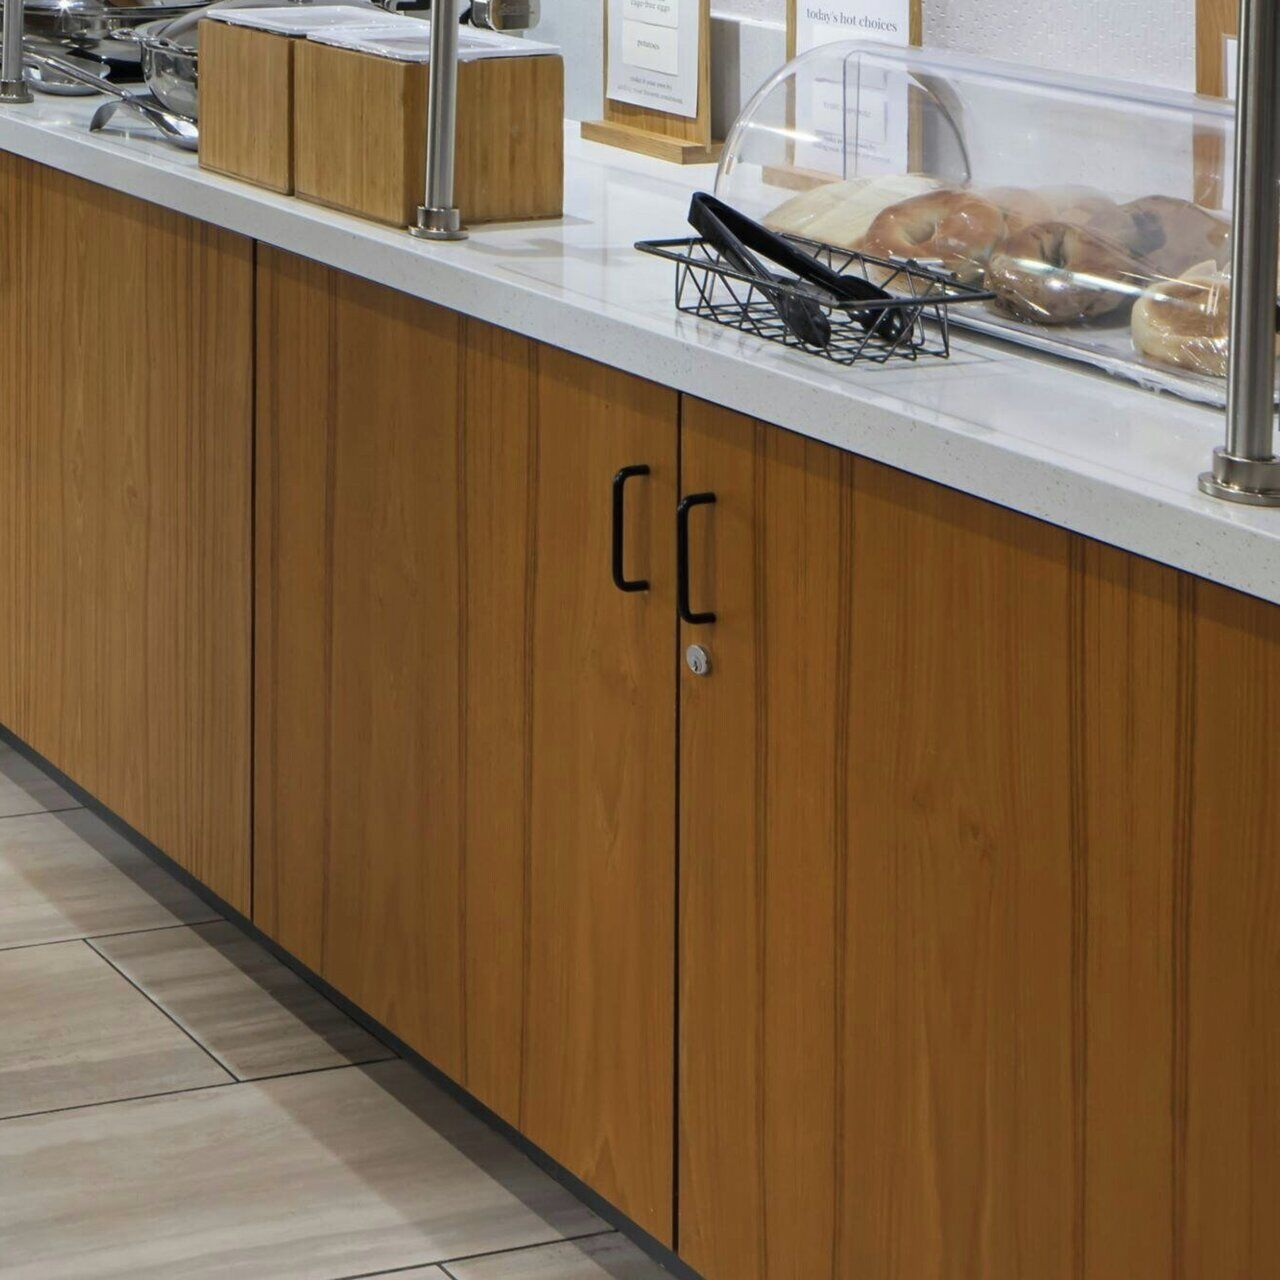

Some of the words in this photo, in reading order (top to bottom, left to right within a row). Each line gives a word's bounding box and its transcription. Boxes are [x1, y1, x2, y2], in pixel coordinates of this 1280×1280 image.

[806, 7, 838, 24] today's
[840, 11, 857, 26] hot
[858, 14, 898, 33] choices
